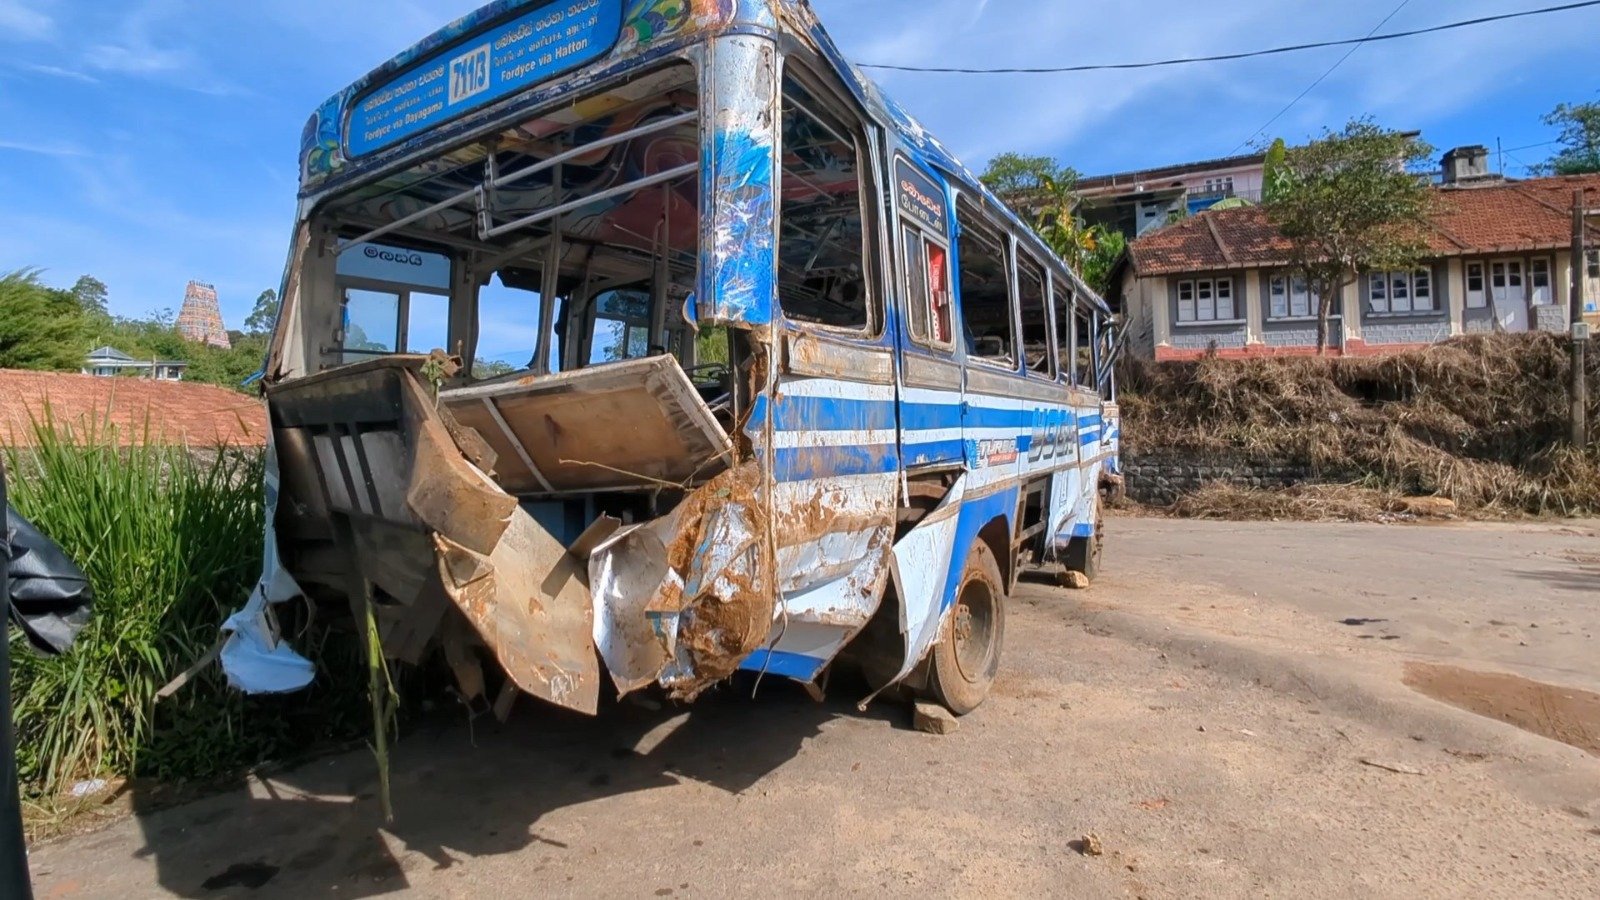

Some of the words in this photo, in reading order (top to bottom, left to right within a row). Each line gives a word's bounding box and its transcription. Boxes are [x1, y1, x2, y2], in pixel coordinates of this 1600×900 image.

[501, 60, 536, 82] Fordyce
[539, 53, 552, 66] via
[555, 38, 588, 60] Hatton
[364, 124, 391, 142] Fordyce
[392, 119, 403, 130] via
[404, 102, 443, 124] Dayagama
